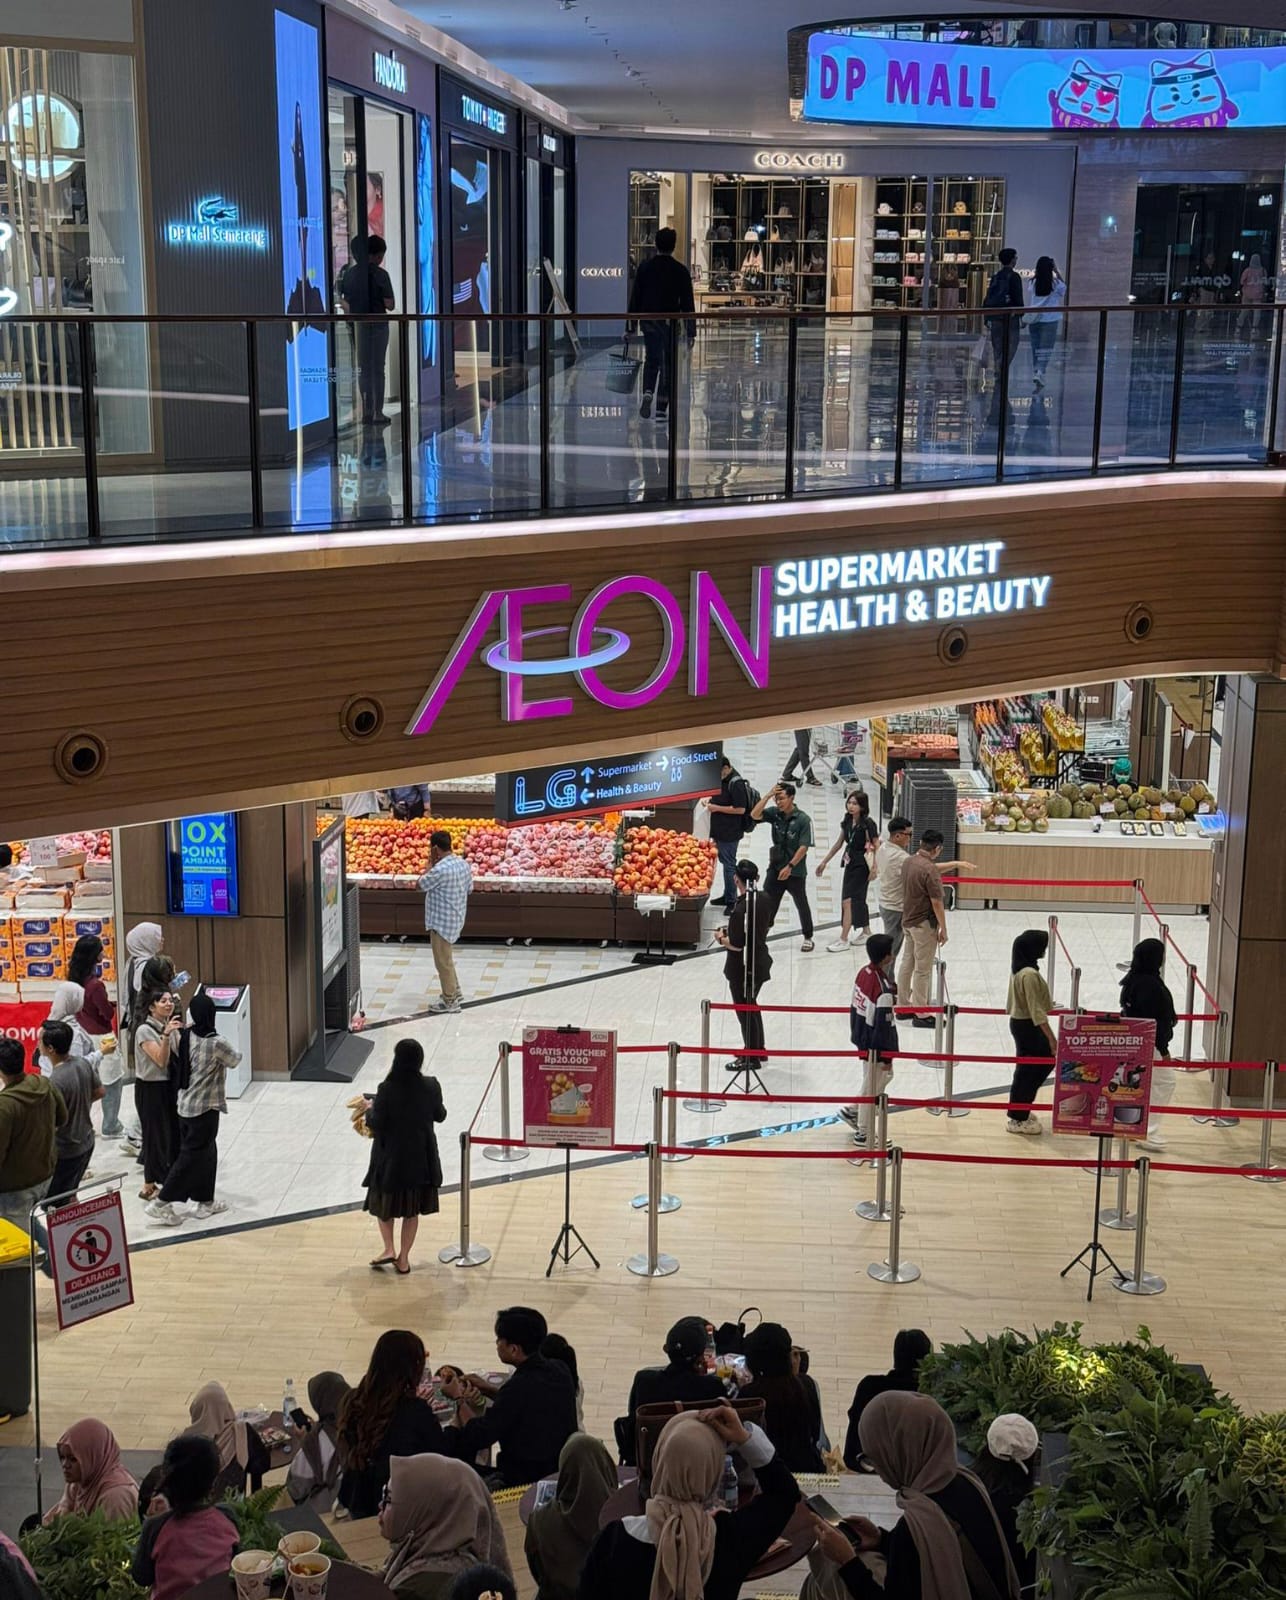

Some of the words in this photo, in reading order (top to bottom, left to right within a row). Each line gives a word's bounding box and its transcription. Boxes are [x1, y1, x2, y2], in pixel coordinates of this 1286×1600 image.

[374, 50, 407, 93] PANDORA
[820, 54, 866, 101] DP
[886, 60, 996, 109] MALL
[755, 152, 845, 169] COACH
[187, 225, 210, 241] Mall
[213, 227, 265, 247] Semarang
[775, 541, 1005, 597] SUPERMARKET
[775, 592, 898, 637] HEALTH
[905, 589, 929, 622] &
[935, 576, 1051, 619] BEAUTY
[598, 761, 652, 778] Supermarket
[671, 754, 693, 766] Food
[693, 751, 718, 763] Street
[515, 768, 577, 814] LG
[596, 786, 624, 799] Health
[625, 784, 632, 793] &
[633, 781, 662, 794] Beauty
[529, 1047, 562, 1056] GRATIS
[563, 1048, 607, 1057] VOUCHER
[1065, 1036, 1087, 1045] TOP
[1089, 1036, 1144, 1046] SPENDER!
[51, 1195, 118, 1225] ANNOUNCEMENT
[70, 1267, 116, 1290] DILARANG
[62, 1286, 100, 1305] MEMBUANG
[100, 1278, 128, 1292] SAMPAH
[70, 1288, 121, 1310] SEMBARANGAN
